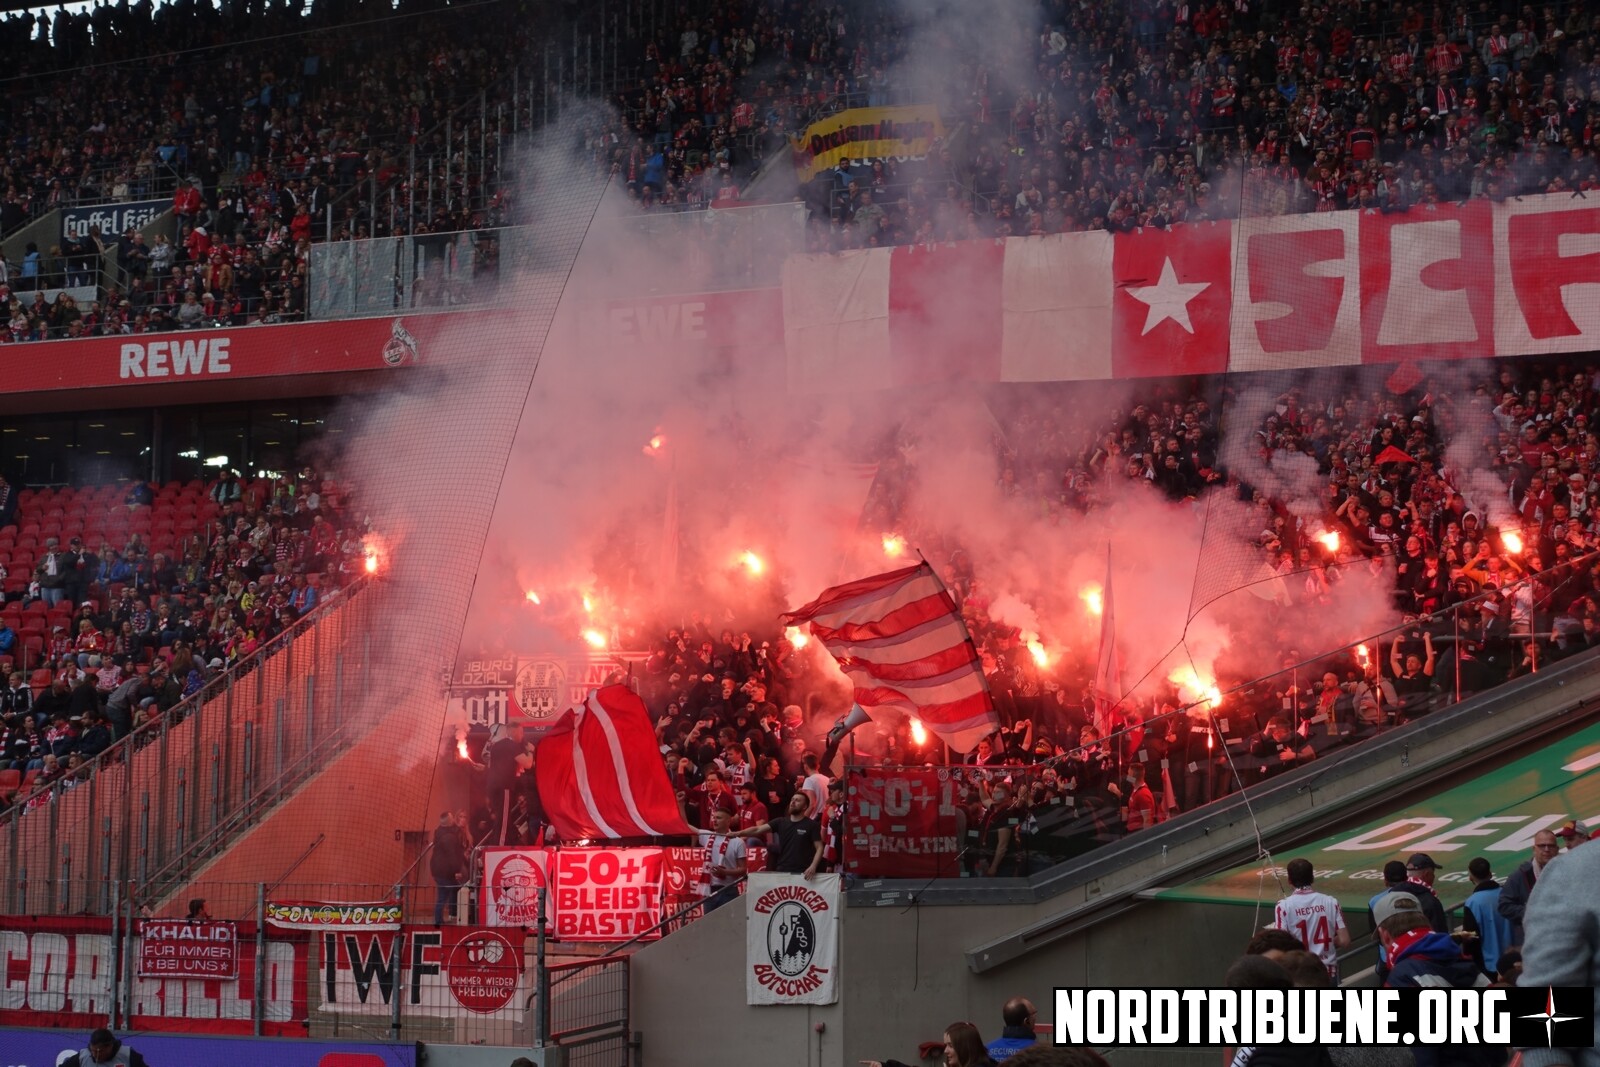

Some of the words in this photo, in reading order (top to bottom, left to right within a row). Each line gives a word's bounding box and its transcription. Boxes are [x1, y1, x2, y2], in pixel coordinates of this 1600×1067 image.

[63, 210, 120, 238] Gaffel
[119, 337, 231, 378] REWE
[559, 852, 662, 886] 50+1
[754, 886, 829, 914] FREIBURGER
[1295, 904, 1326, 917] HECTOR
[146, 925, 231, 942] KHALID
[557, 912, 660, 936] BASTA!
[1295, 915, 1332, 953] 14
[144, 943, 175, 957] FÜR
[179, 945, 232, 959] IMMER
[156, 959, 180, 970] BEI
[183, 960, 219, 971] UNS
[323, 931, 443, 1005] IWF
[458, 986, 508, 998] FREIBURG
[484, 977, 514, 987] WIEDER
[753, 964, 829, 996] BOTSCHAFT
